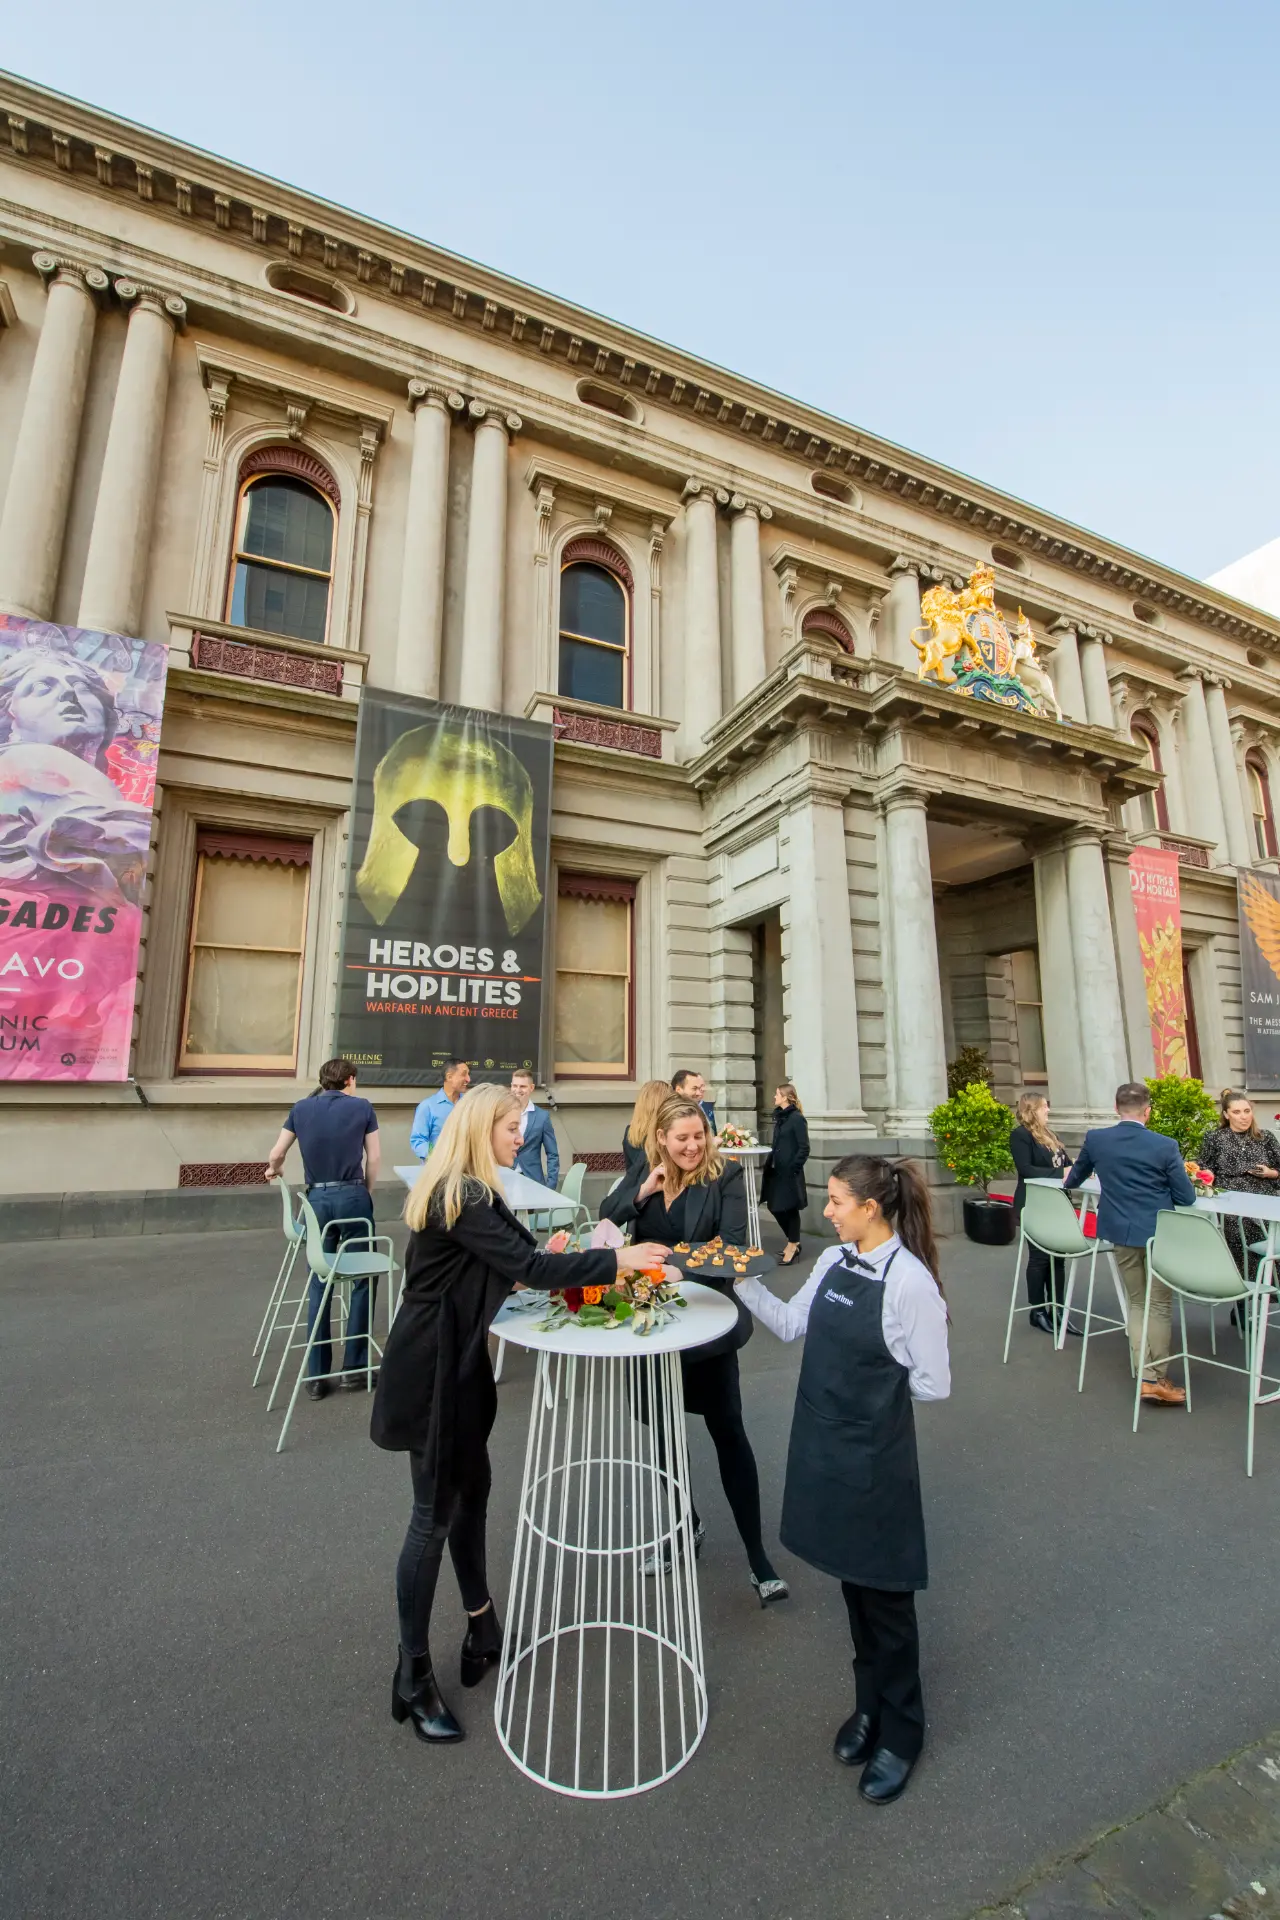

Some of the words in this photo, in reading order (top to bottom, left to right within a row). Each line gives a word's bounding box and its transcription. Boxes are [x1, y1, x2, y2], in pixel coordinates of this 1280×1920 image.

[368, 938, 495, 972] HEROES
[501, 949, 521, 974] &
[366, 972, 522, 1006] HOPLITES
[1250, 991, 1273, 1004] SAM
[366, 1001, 417, 1015] WARFARE
[421, 1004, 432, 1015] IN
[434, 1005, 478, 1017] ANCIENT
[481, 1007, 519, 1019] GREECE
[1249, 1016, 1263, 1026] THE
[342, 1053, 383, 1061] HELLENIC
